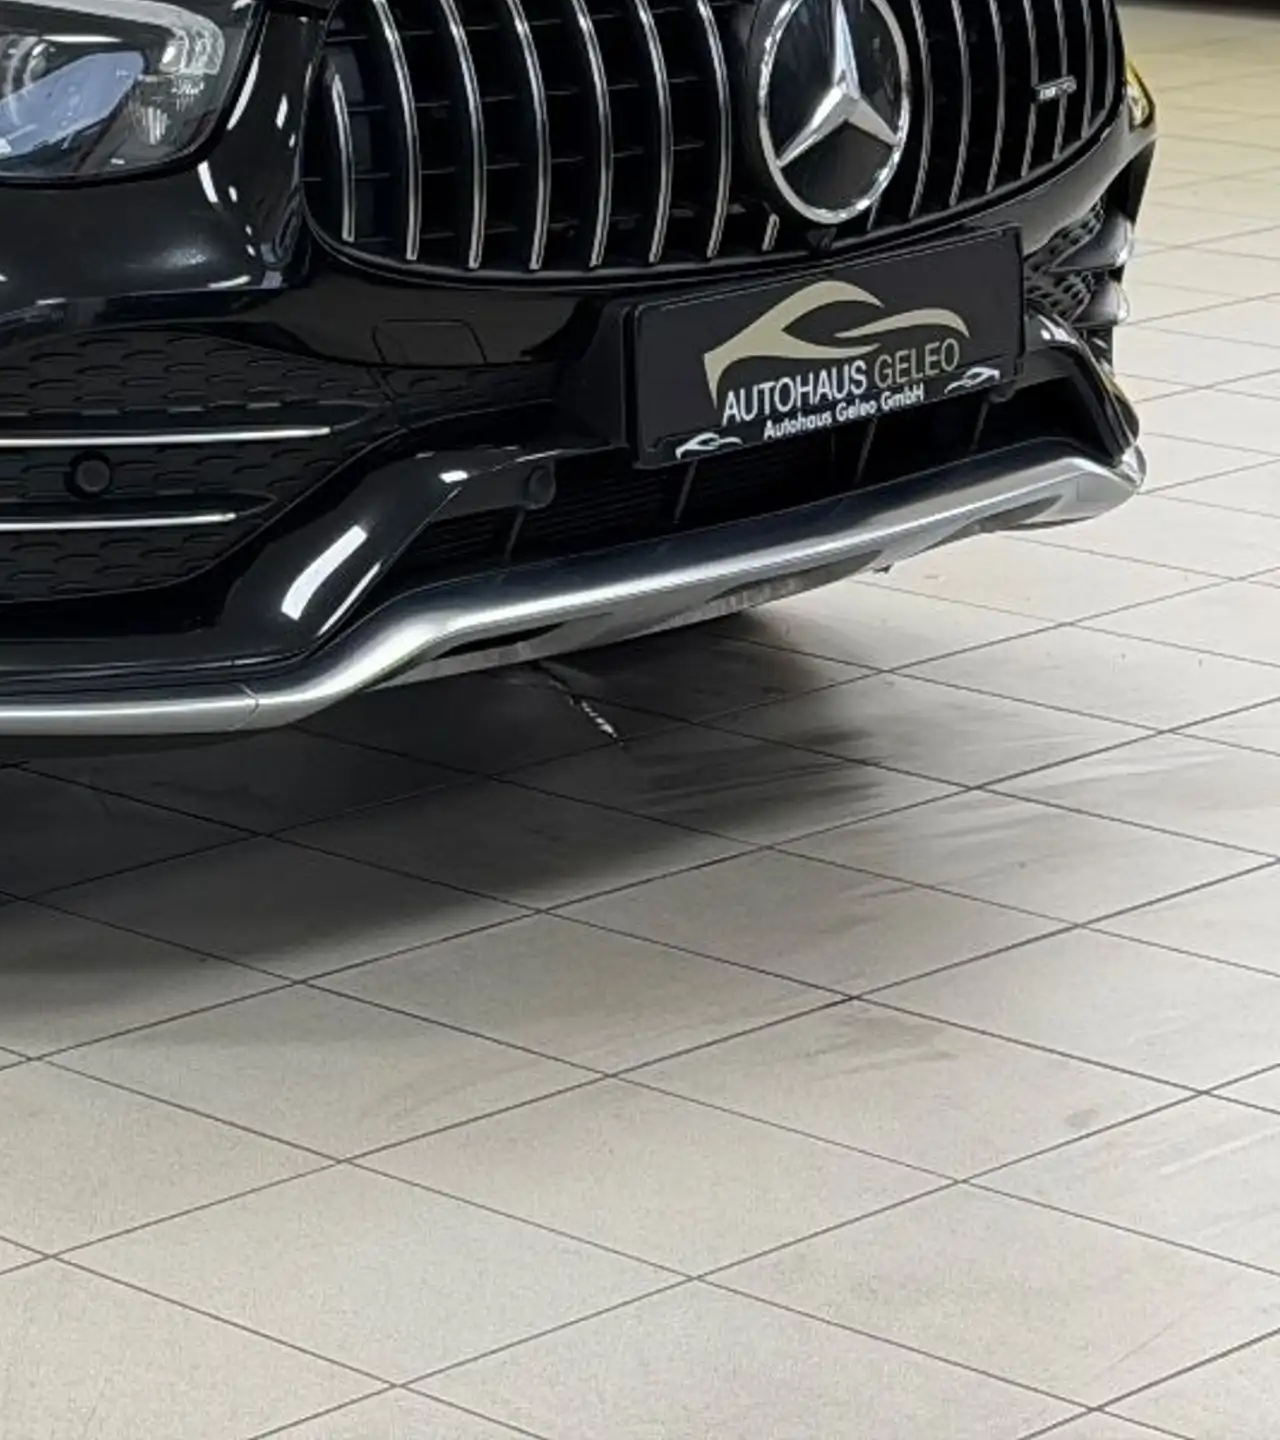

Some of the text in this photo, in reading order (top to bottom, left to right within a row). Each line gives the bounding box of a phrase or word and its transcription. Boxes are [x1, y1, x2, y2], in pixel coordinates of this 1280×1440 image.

[721, 338, 960, 427] AUTOHAUS GELEO
[763, 382, 925, 440] Autohaus Geleo GmbH
